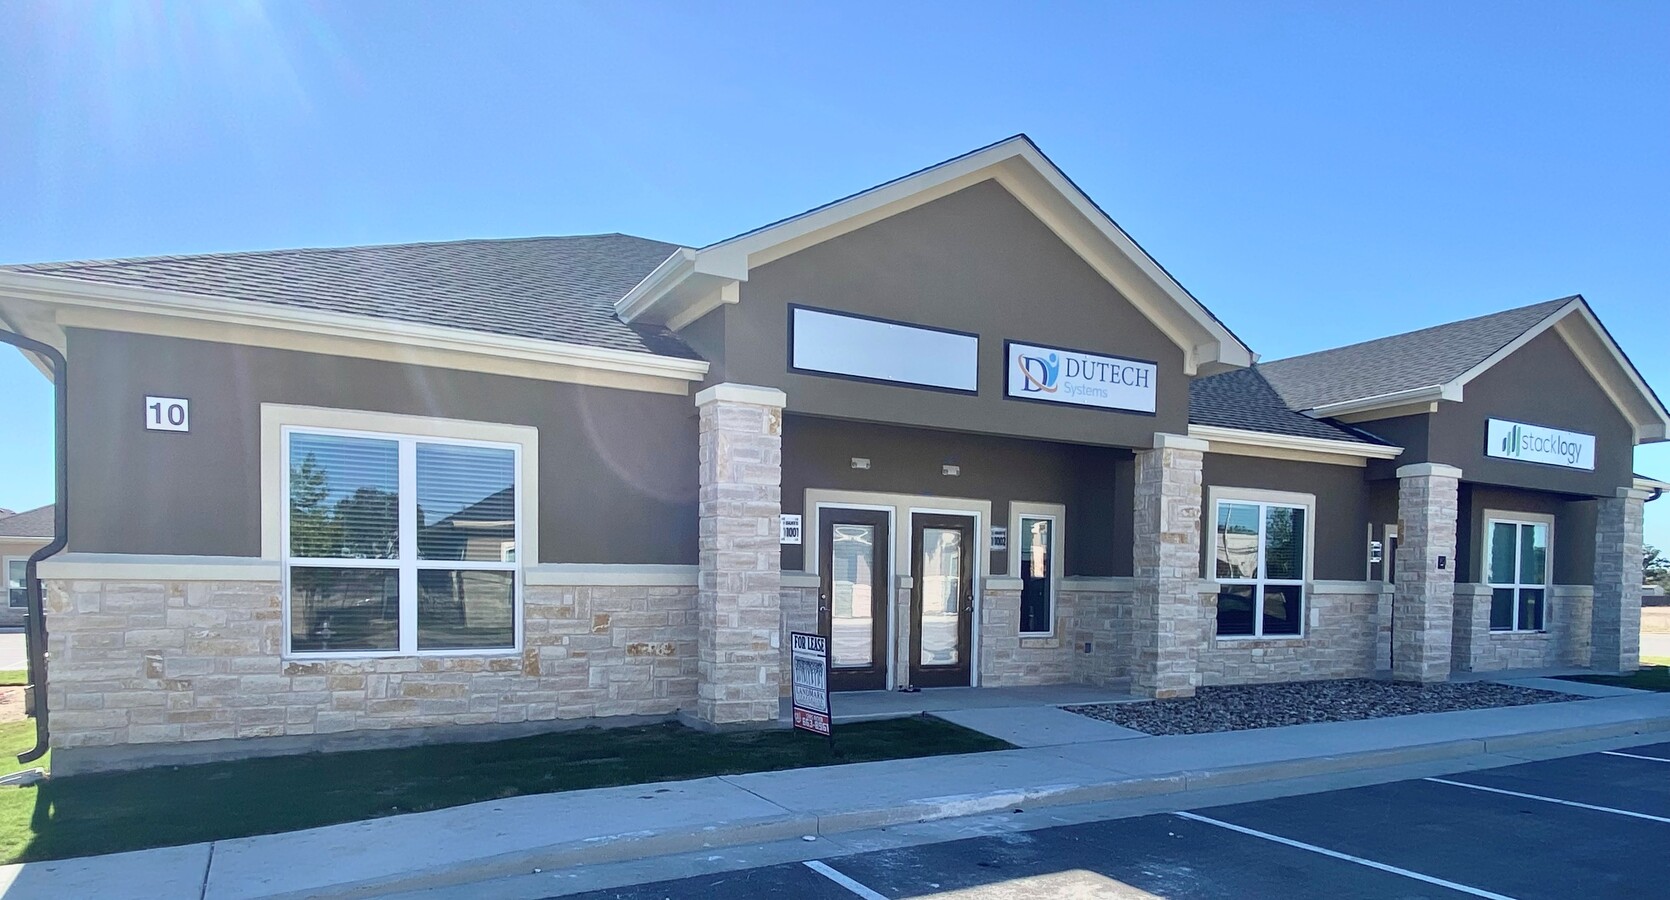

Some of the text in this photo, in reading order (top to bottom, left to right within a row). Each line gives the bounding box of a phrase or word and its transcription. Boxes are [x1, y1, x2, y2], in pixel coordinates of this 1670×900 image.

[1065, 357, 1150, 388] DUTECH
[1064, 381, 1108, 398] Systems
[149, 402, 185, 426] 10
[1521, 432, 1582, 464] stacklogy
[794, 635, 825, 653] FOR LEASE
